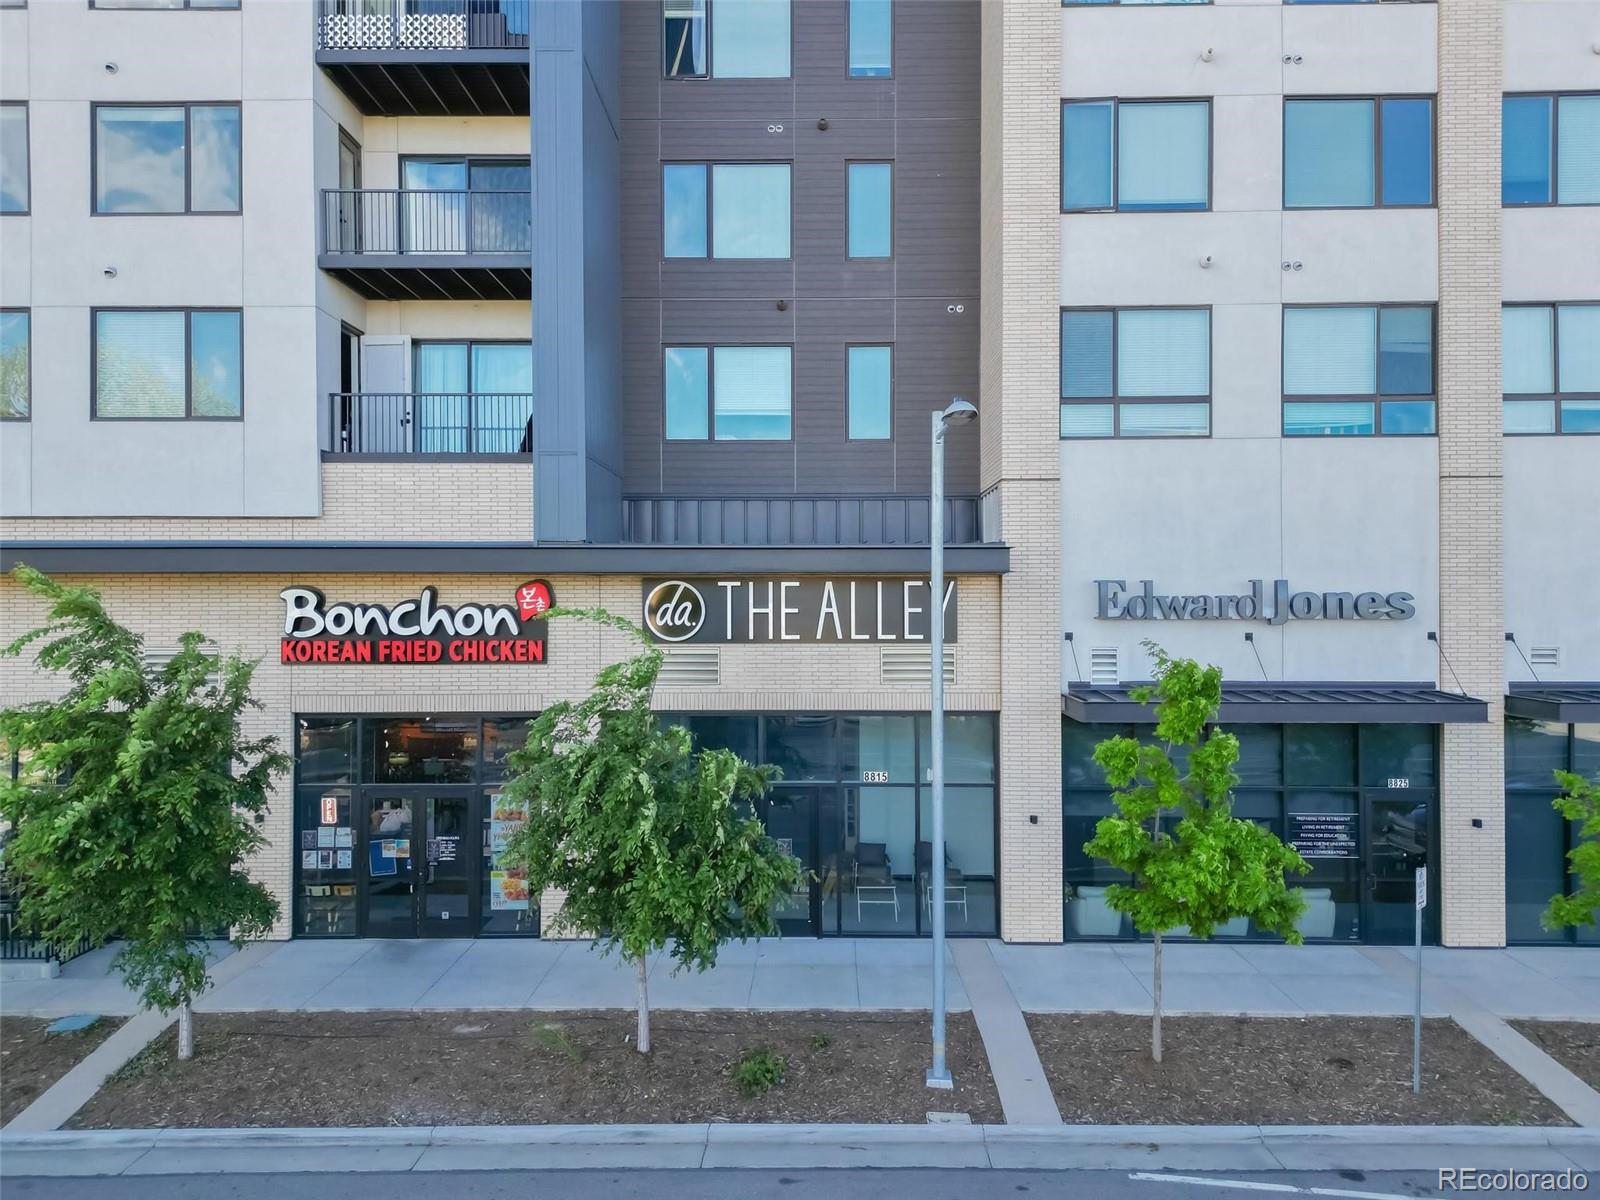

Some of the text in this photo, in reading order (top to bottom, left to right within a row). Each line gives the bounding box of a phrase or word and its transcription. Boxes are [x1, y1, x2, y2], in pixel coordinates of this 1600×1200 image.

[280, 588, 519, 638] Bonchon
[717, 581, 800, 640] THE
[1093, 579, 1416, 625] Edward Jones
[281, 639, 543, 662] KOREAN FRIED CHICKEN
[864, 771, 888, 782] 8815
[1388, 779, 1409, 788] 8825
